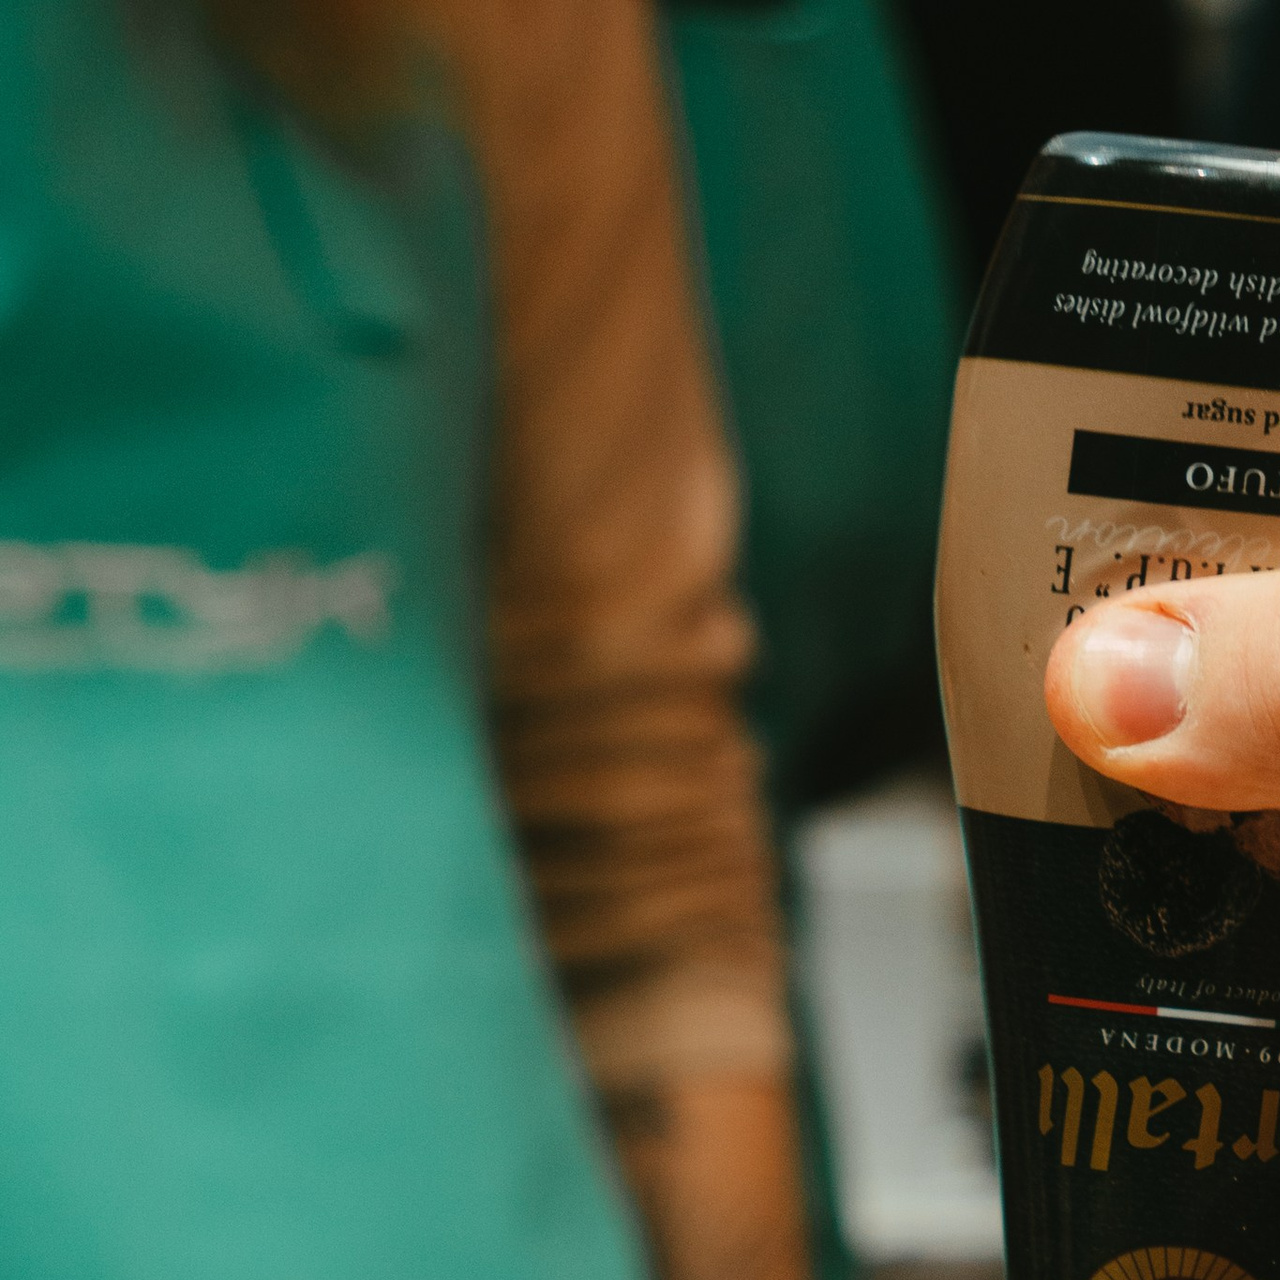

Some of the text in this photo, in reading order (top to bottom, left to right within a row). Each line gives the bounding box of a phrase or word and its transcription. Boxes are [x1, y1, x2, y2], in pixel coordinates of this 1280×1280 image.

[1081, 248, 1219, 296] decorating
[1053, 293, 1126, 327] dishes
[1132, 301, 1250, 338] wildfowl
[1181, 396, 1257, 426] sugar
[1051, 545, 1074, 595] E
[1136, 972, 1186, 997] Italy
[1191, 975, 1217, 1000] of
[1101, 1027, 1237, 1061] MODENA
